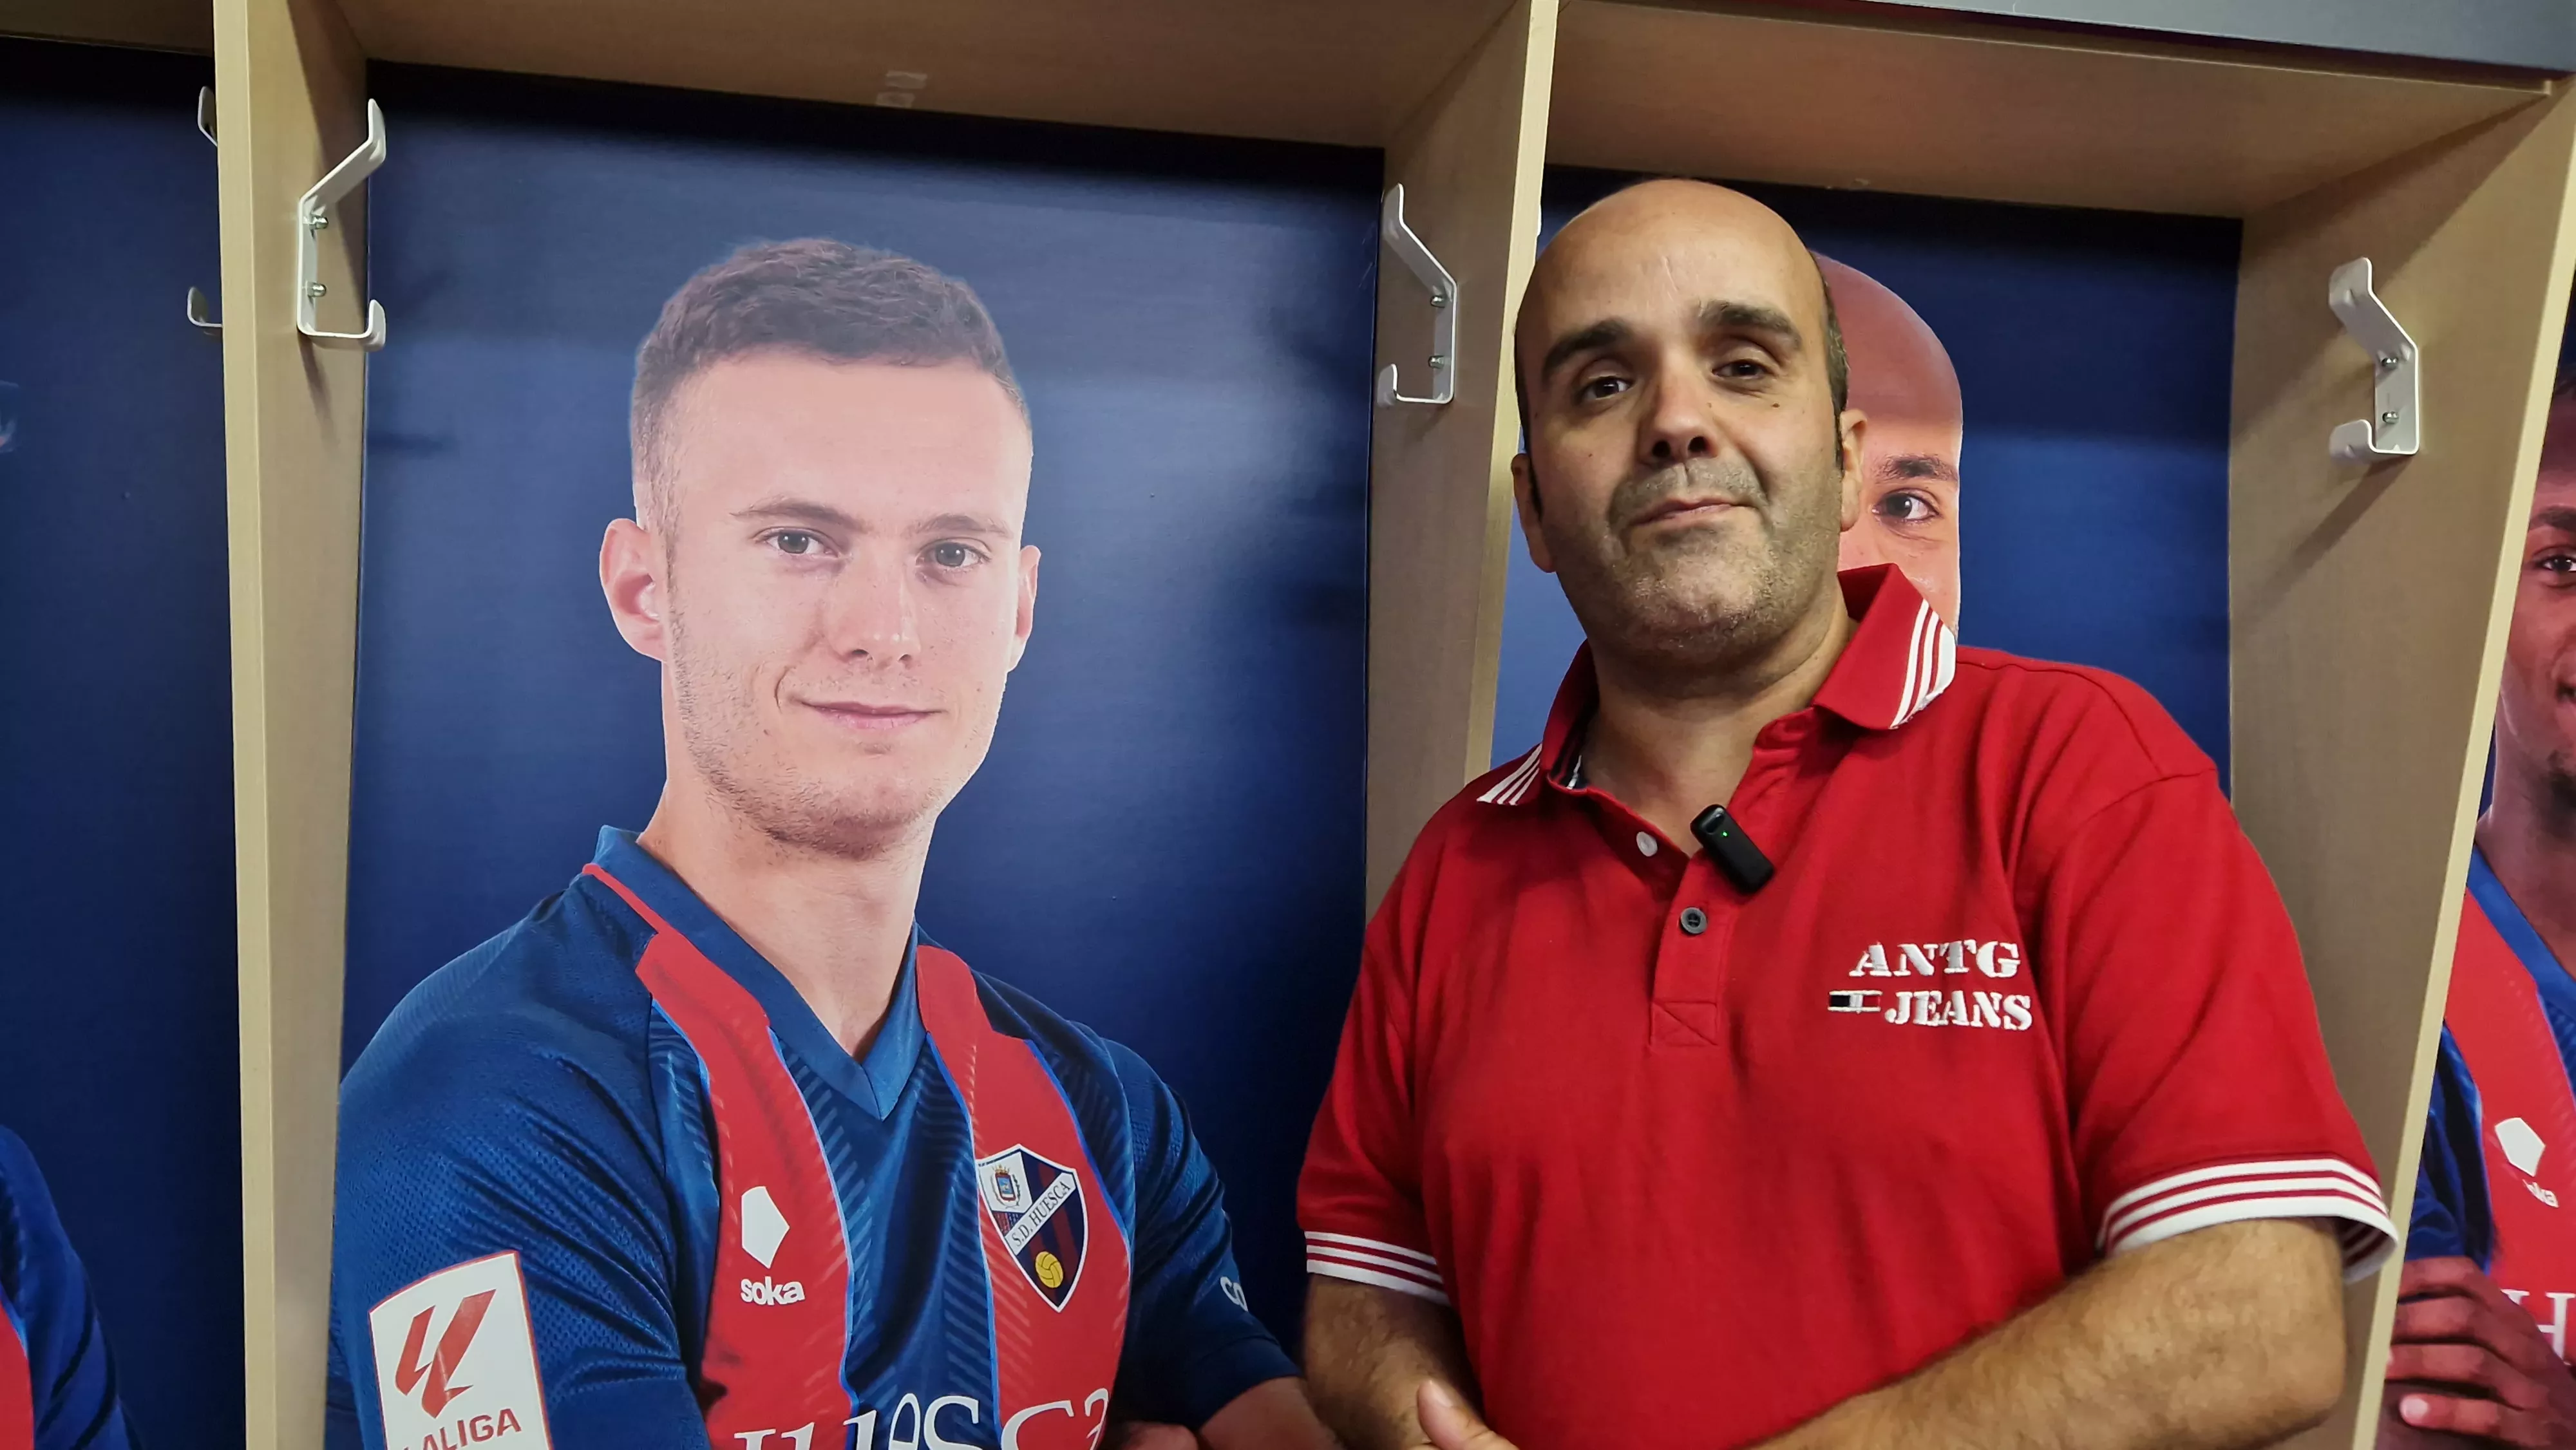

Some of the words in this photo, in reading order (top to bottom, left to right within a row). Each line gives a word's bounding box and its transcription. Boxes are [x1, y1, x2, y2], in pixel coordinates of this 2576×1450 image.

[1849, 939, 2021, 977] ANTG
[1884, 990, 2032, 1030] JEANS
[1012, 1224, 1033, 1247] S.D.
[1028, 1182, 1070, 1227] HUESCA
[740, 1276, 805, 1305] soka
[403, 1408, 522, 1450] ALIGA
[734, 1388, 1108, 1450] esca
